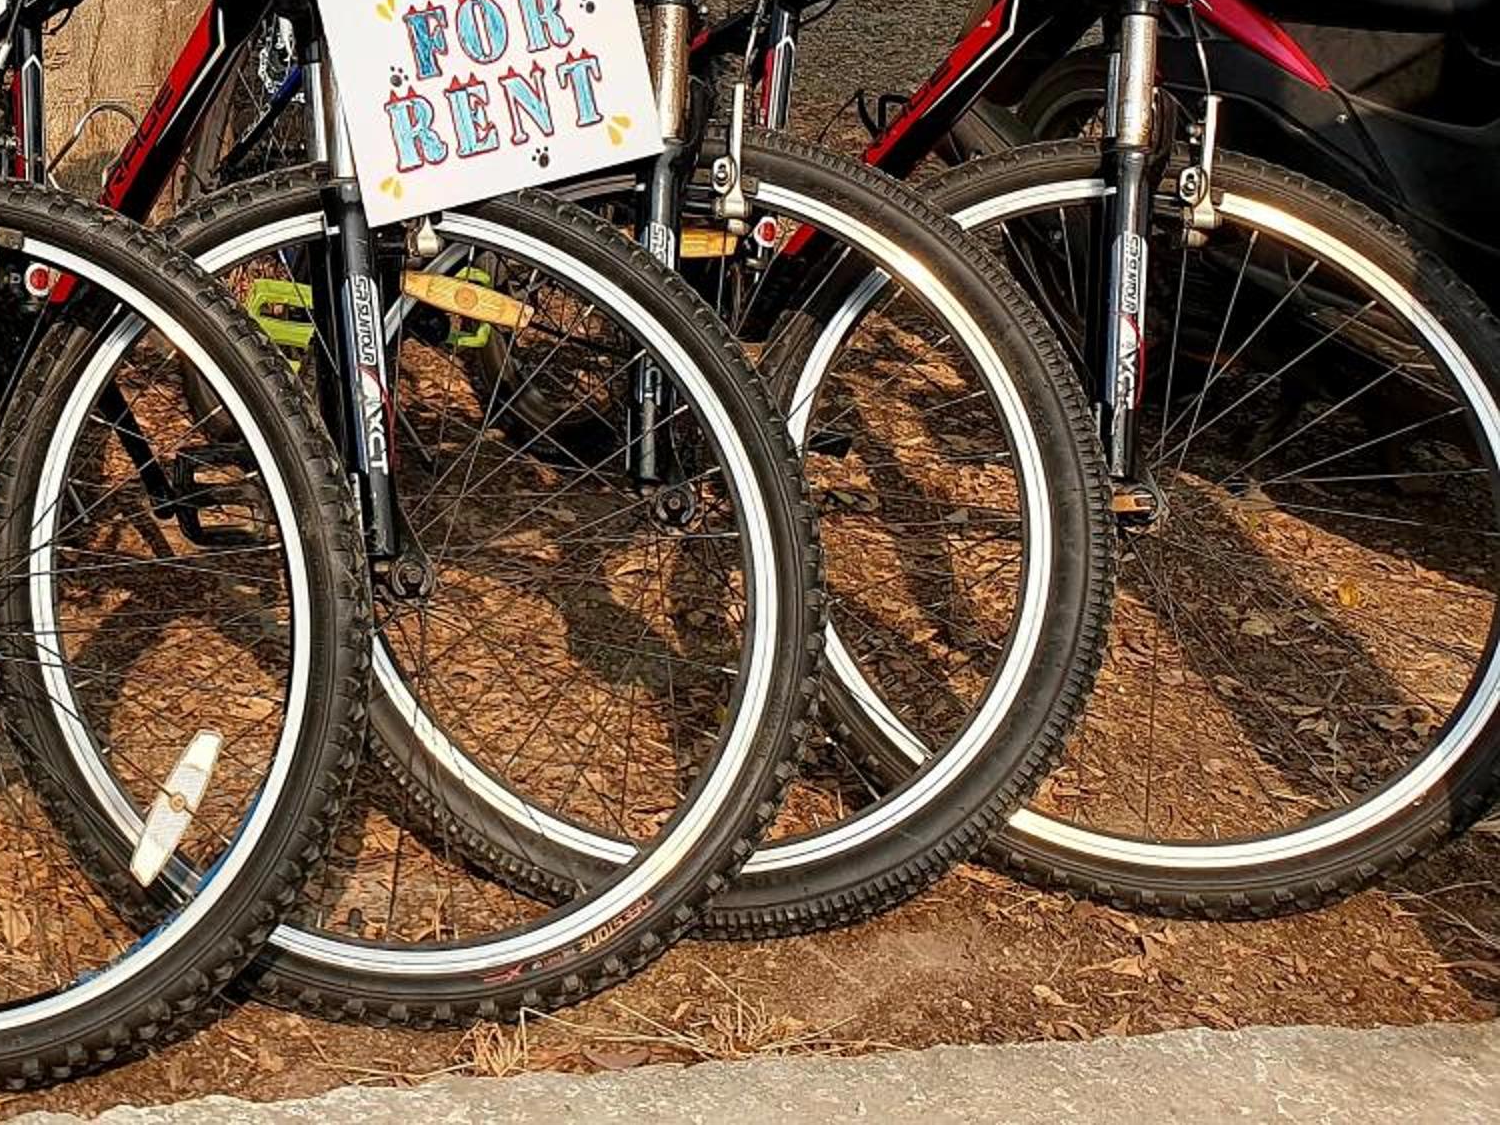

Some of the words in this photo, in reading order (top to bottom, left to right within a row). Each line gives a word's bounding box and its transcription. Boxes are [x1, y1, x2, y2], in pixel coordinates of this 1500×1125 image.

[384, 47, 605, 174] RENT
[355, 276, 370, 302] SR
[357, 303, 376, 365] SUNTOUR
[1117, 356, 1136, 410] XCT
[366, 412, 389, 475] XCT
